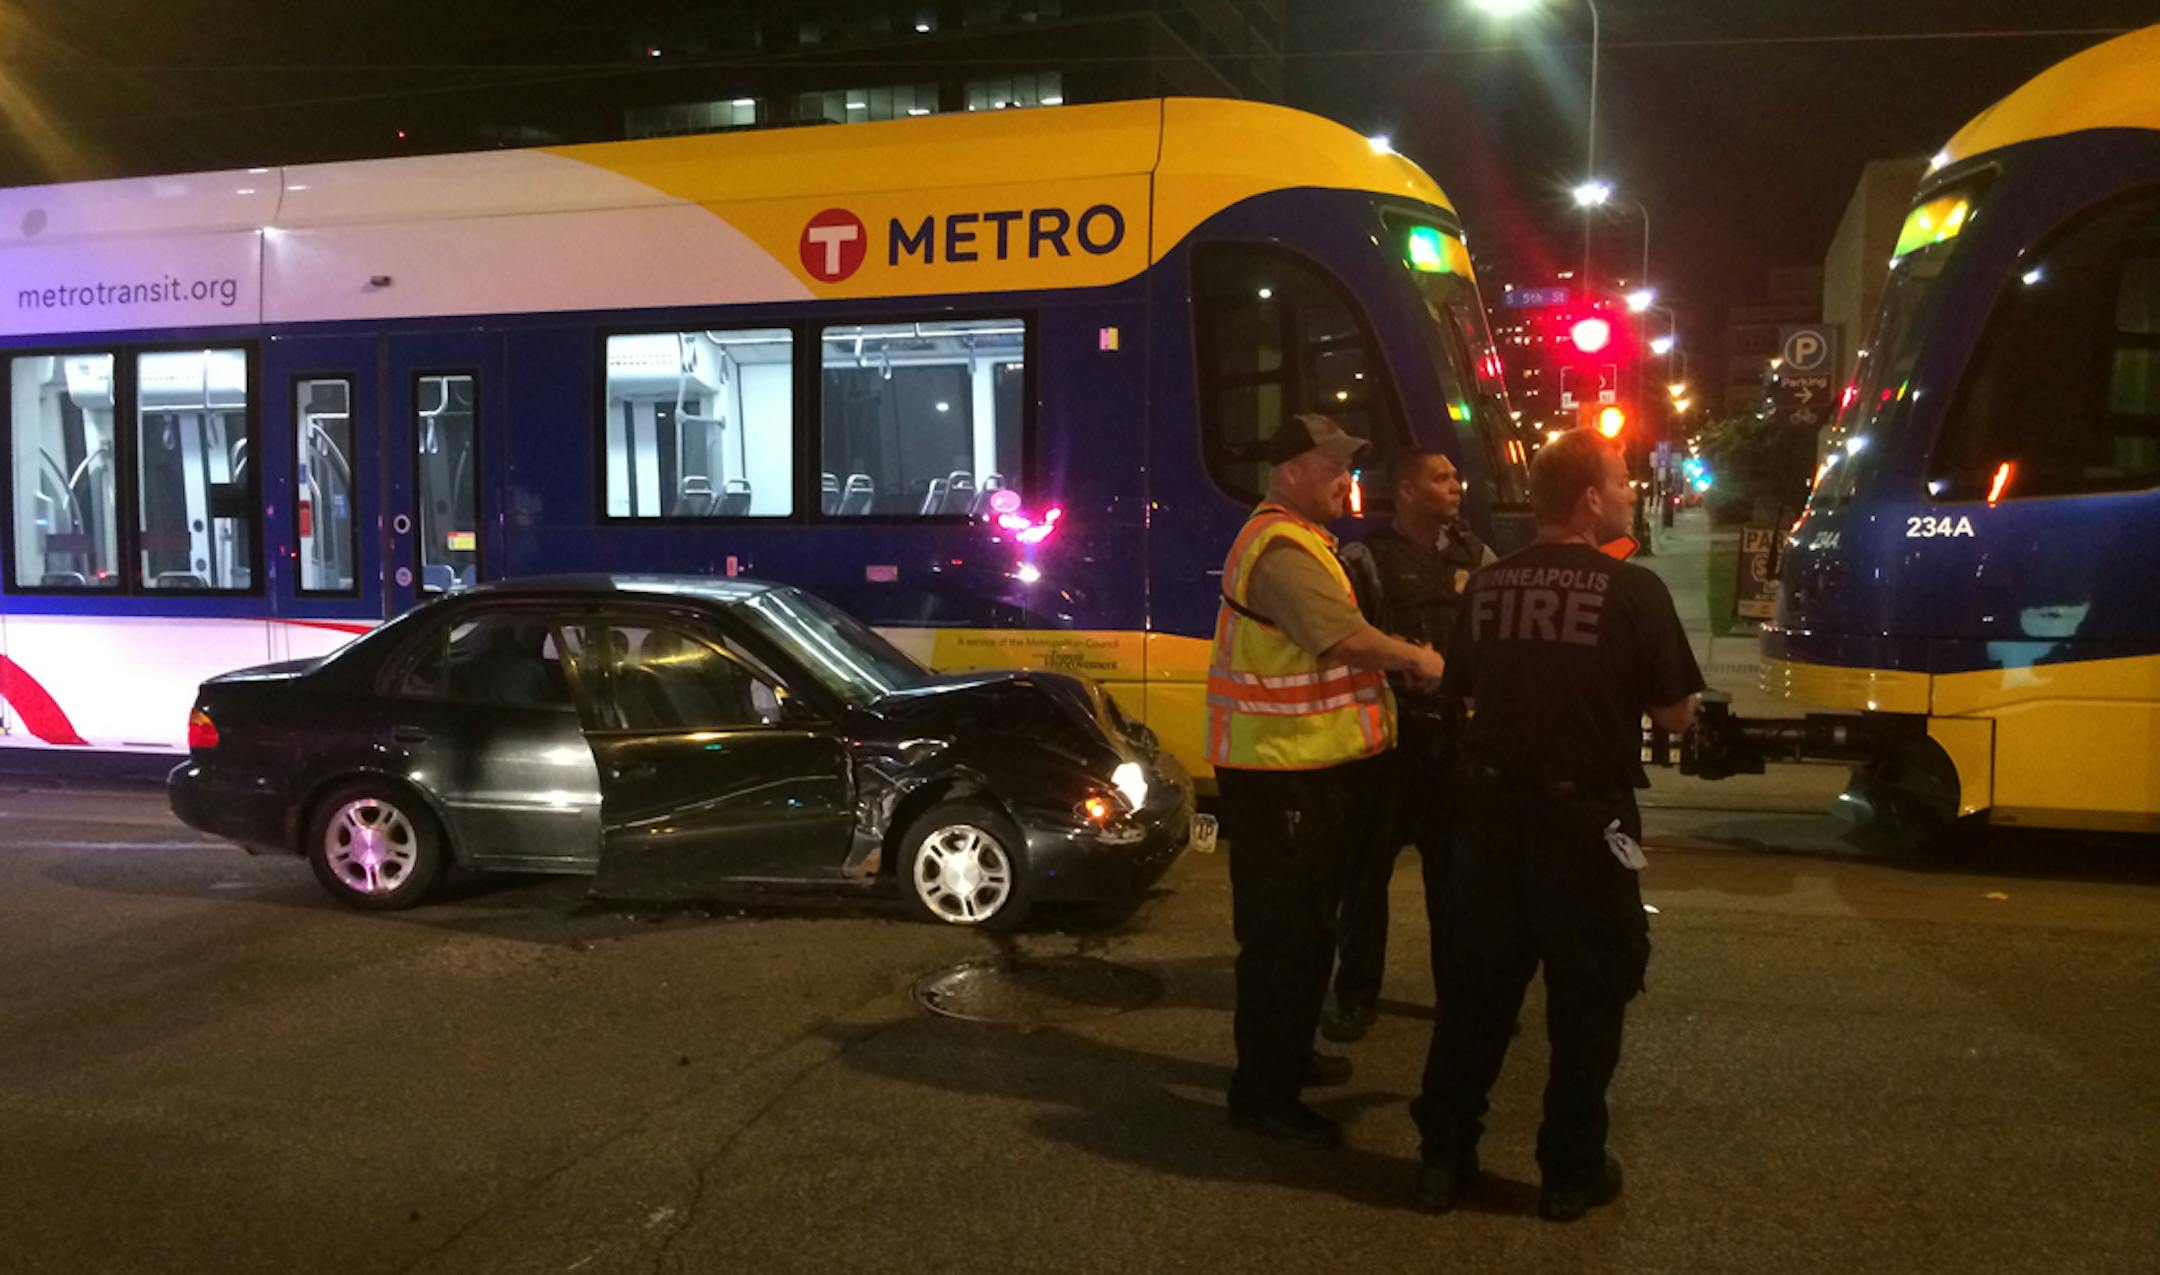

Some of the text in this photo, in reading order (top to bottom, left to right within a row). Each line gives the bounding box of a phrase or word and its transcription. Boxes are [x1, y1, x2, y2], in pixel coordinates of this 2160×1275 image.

[808, 204, 1126, 275] T METRO
[18, 274, 238, 308] metrotransit.org
[1521, 292, 1543, 305] 5th
[1551, 290, 1565, 303] St
[1795, 336, 1818, 365] P
[1780, 375, 1828, 389] Parking
[1906, 515, 1975, 538] 234A
[1746, 531, 1785, 550] PAR
[1470, 588, 1606, 648] FIRE
[966, 638, 996, 647] service
[998, 637, 1008, 647] of
[1008, 637, 1024, 647] the
[1086, 638, 1119, 649] Council
